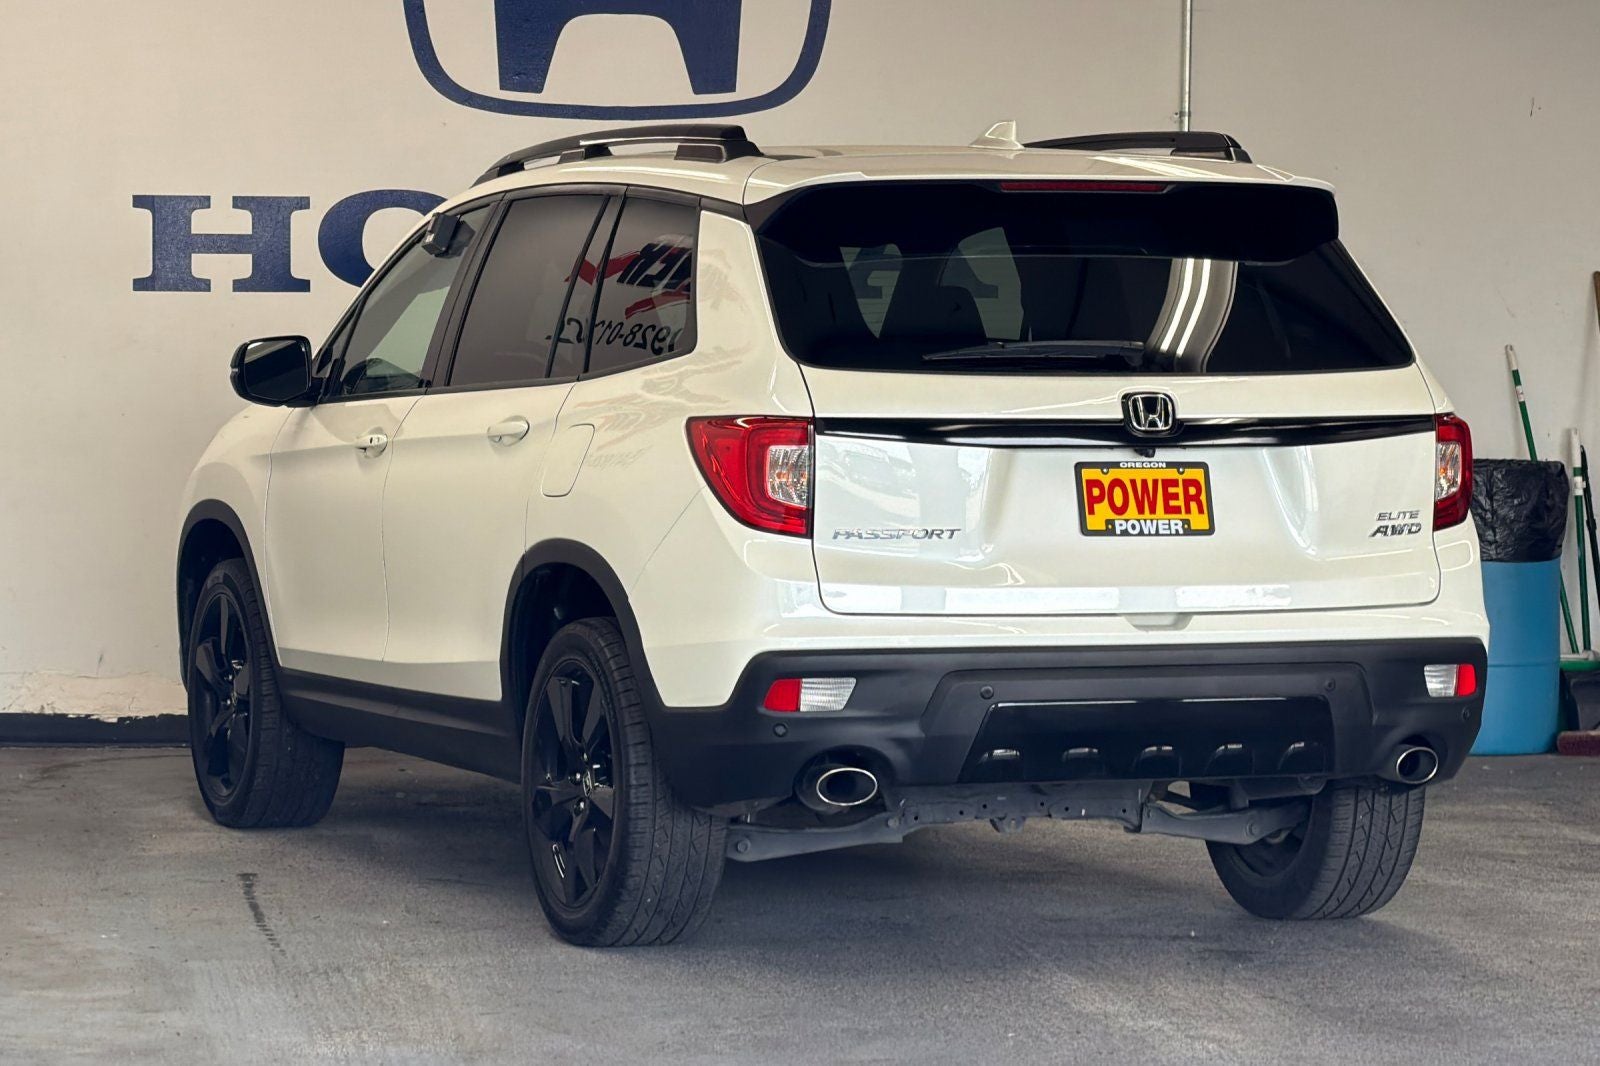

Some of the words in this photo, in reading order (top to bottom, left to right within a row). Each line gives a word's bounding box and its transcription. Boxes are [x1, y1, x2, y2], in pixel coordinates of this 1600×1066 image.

[1119, 461, 1167, 469] OREGON
[1085, 477, 1205, 516] POWER
[1376, 509, 1421, 521] ELITE
[1114, 519, 1184, 535] POWER
[1368, 522, 1422, 538] AWD
[831, 528, 962, 541] PASSPORT
